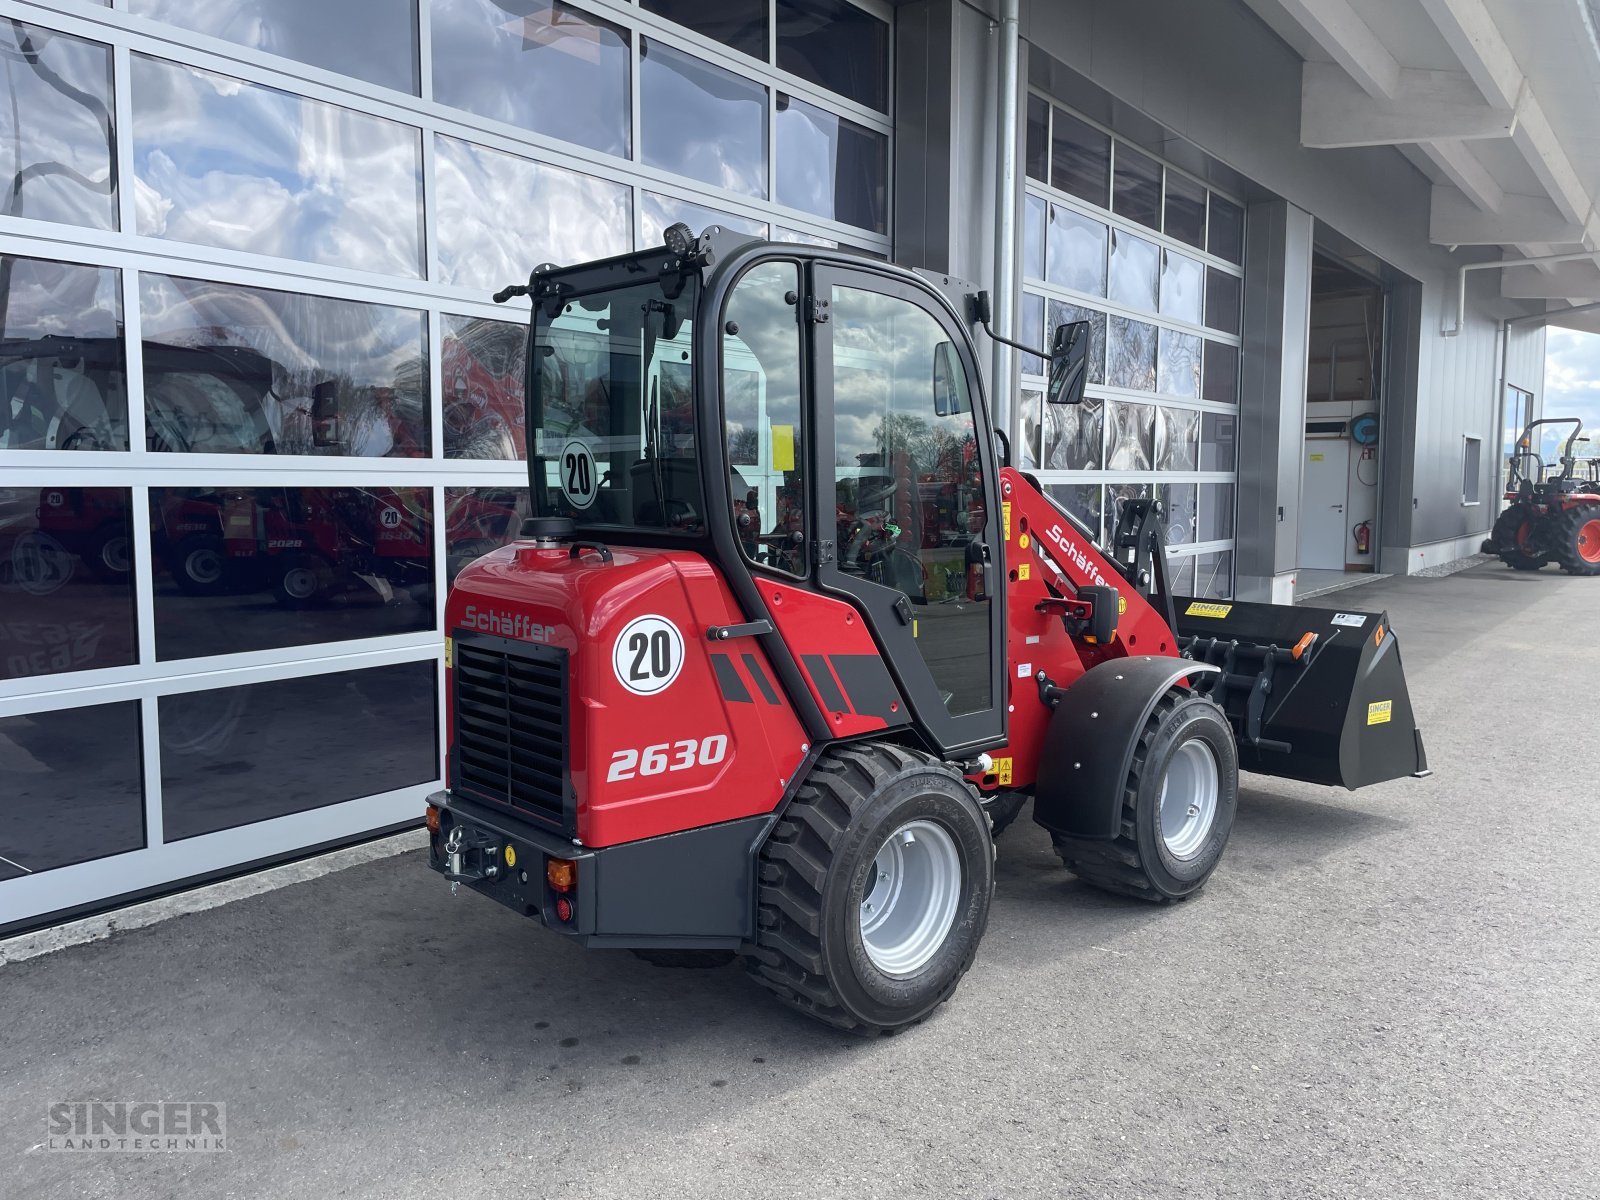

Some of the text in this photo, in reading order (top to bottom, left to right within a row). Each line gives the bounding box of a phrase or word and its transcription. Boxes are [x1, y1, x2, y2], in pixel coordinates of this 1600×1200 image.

[566, 452, 591, 496] 20
[384, 511, 398, 525] 20
[268, 538, 303, 549] 2028
[1190, 603, 1230, 612] SINGER
[460, 605, 556, 643] Schäffer
[628, 629, 672, 682] 20
[1369, 702, 1391, 713] SINGER
[606, 733, 728, 783] 2630
